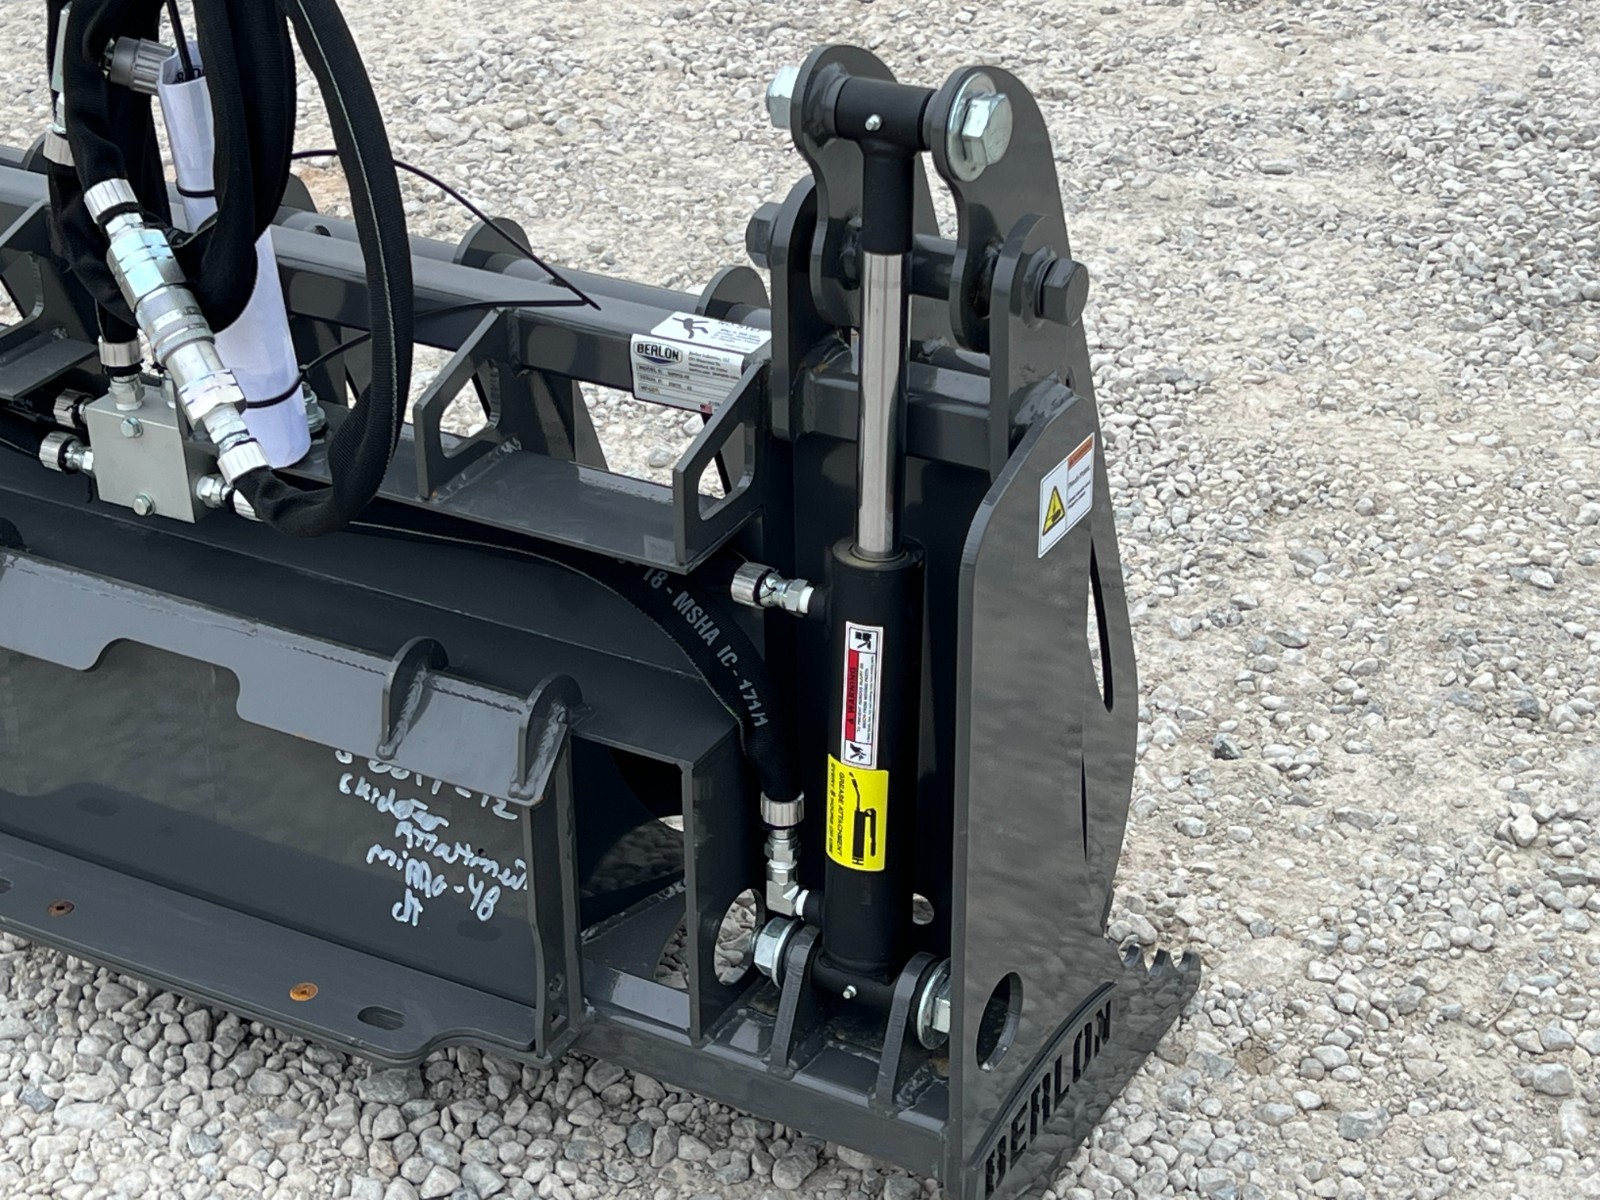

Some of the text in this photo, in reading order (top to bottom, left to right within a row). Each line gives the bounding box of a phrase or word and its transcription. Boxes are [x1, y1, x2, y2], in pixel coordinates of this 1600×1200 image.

[636, 342, 680, 361] BERLON
[672, 590, 720, 646] MSHA
[985, 1000, 1112, 1200] BERLON
